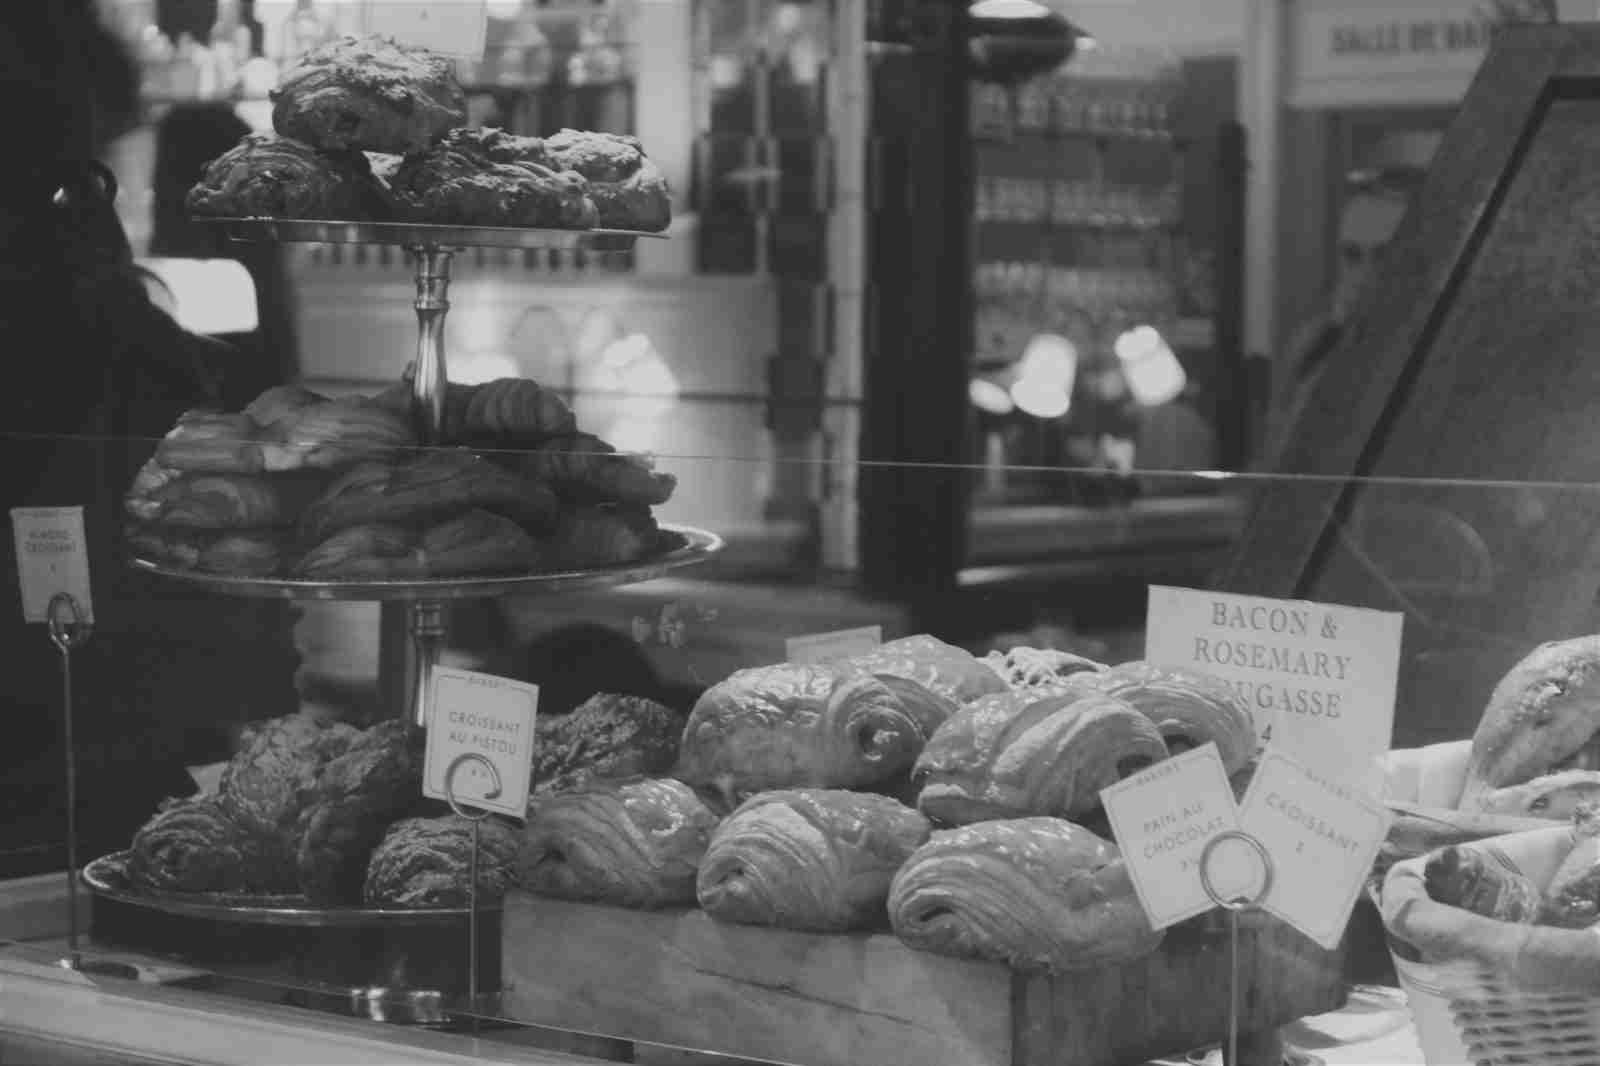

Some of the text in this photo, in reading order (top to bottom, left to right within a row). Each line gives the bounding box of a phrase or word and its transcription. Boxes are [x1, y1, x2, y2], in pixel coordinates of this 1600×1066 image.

[1211, 602, 1339, 639] BACON &
[1193, 637, 1352, 680] ROSEMARY
[450, 712, 521, 735] CROISSANT
[1265, 792, 1360, 852] CROISSANT
